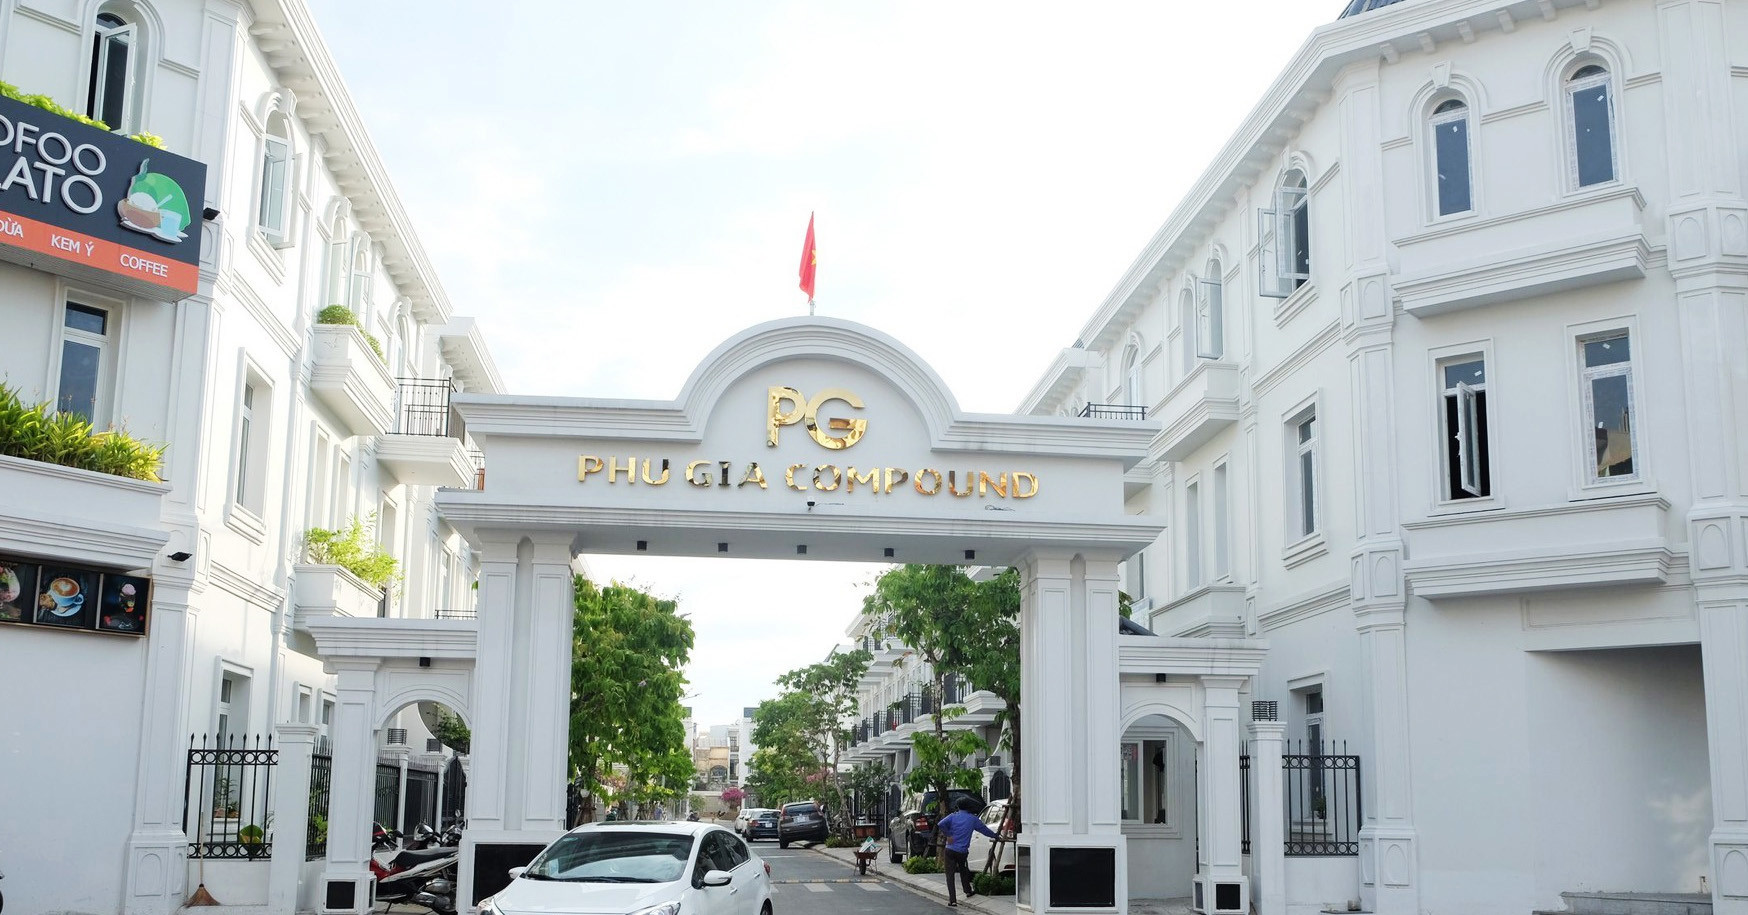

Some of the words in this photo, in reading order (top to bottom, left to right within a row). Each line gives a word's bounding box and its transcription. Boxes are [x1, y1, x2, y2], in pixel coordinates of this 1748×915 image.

[0, 156, 102, 213] ATO
[51, 234, 80, 253] KEM
[85, 241, 94, 257] Ý
[120, 253, 168, 277] COFFEE
[766, 386, 868, 450] PG
[578, 455, 669, 485] PHU
[685, 460, 767, 488] GIA
[785, 463, 1039, 498] COMPOUND
